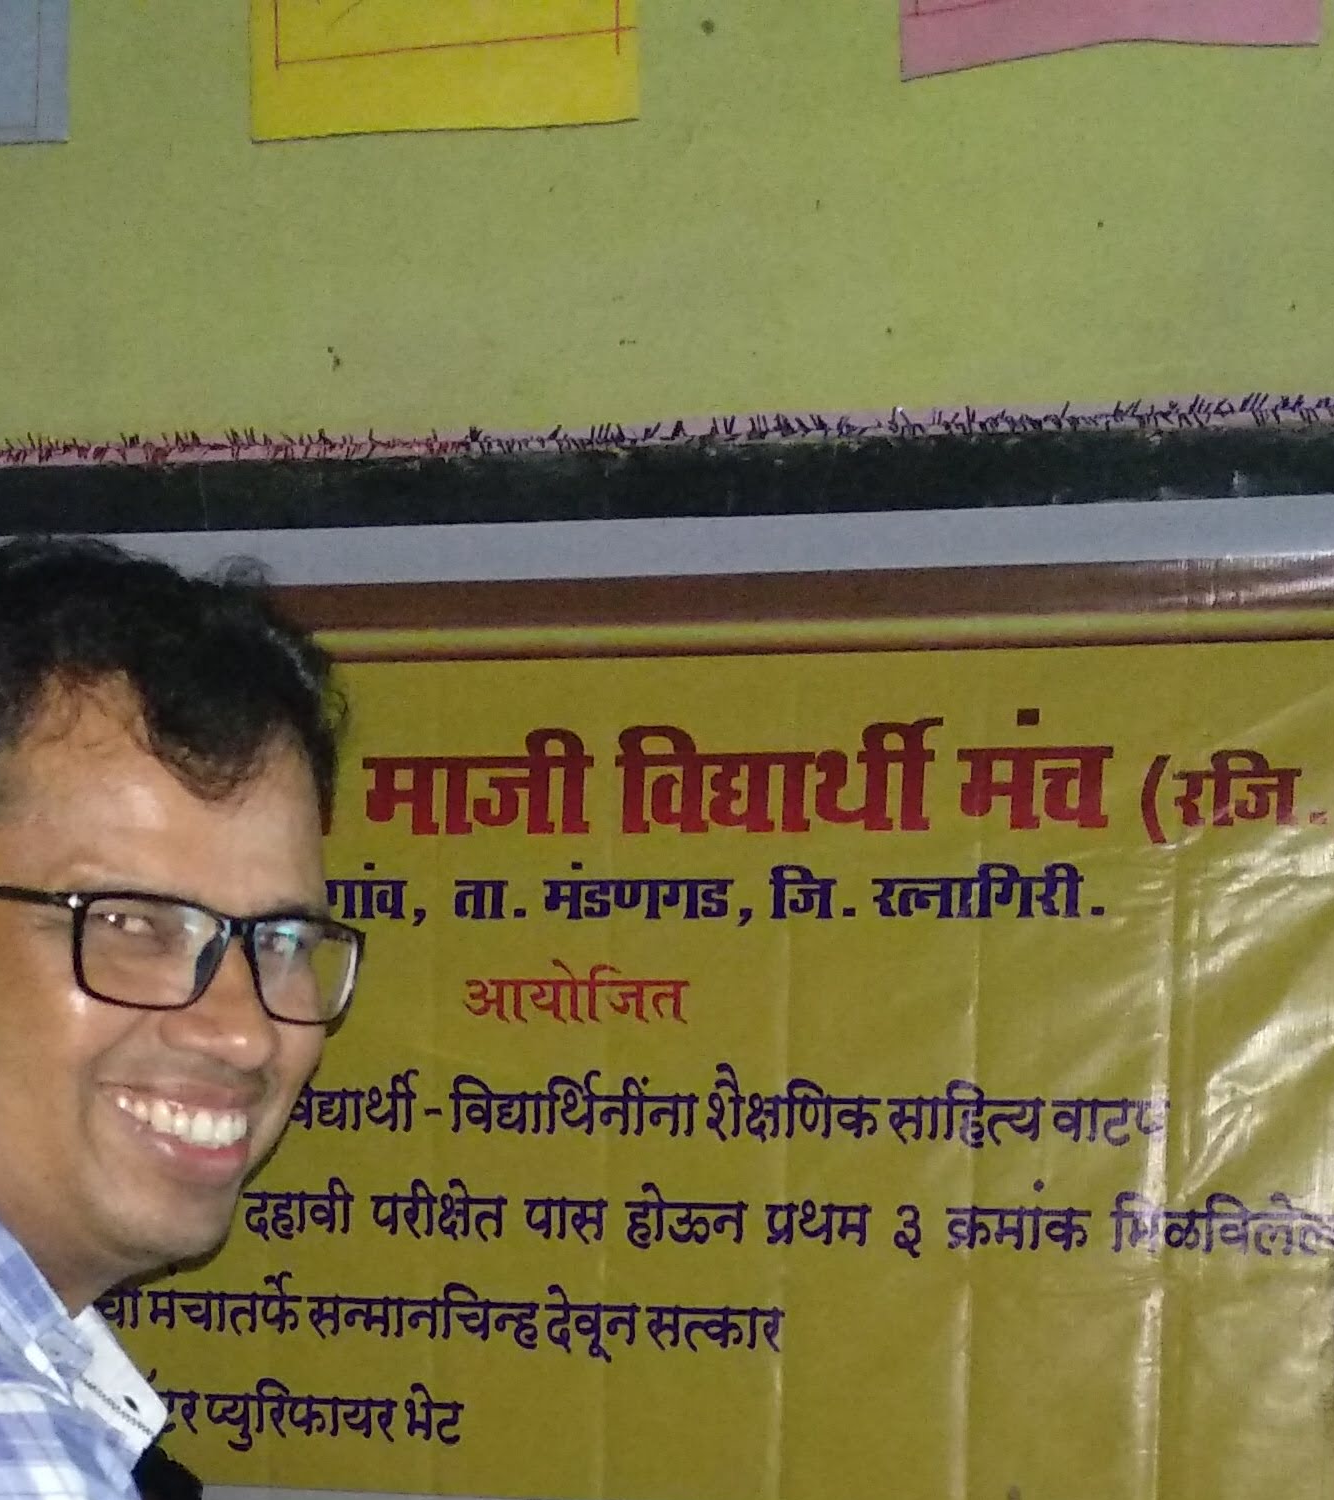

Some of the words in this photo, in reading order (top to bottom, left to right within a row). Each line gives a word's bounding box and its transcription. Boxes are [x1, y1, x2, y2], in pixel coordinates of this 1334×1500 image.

[363, 728, 593, 834] माजी
[615, 717, 943, 832] विद्यार्थी
[957, 708, 1114, 830] मंच
[325, 862, 426, 926] गांव,
[454, 879, 526, 920] ता.
[543, 861, 752, 927] मंडणगड,
[769, 864, 856, 920] जि.
[871, 862, 1105, 919] रत्नागिरी.
[464, 959, 690, 1024] आयोजित
[706, 1062, 881, 1144] शैक्षणिक
[887, 1079, 1046, 1149] साहित्य
[243, 1177, 355, 1241] दहावी
[371, 1178, 508, 1242] परीक्षेत
[524, 1198, 608, 1244] पास
[625, 1182, 749, 1249] होऊन
[766, 1199, 872, 1247] प्रथम
[893, 1204, 922, 1258] ३
[946, 1179, 1092, 1250] क्रमांक
[545, 1284, 642, 1363] देवून
[645, 1303, 786, 1352] सत्कार
[405, 1382, 465, 1445] भेट
